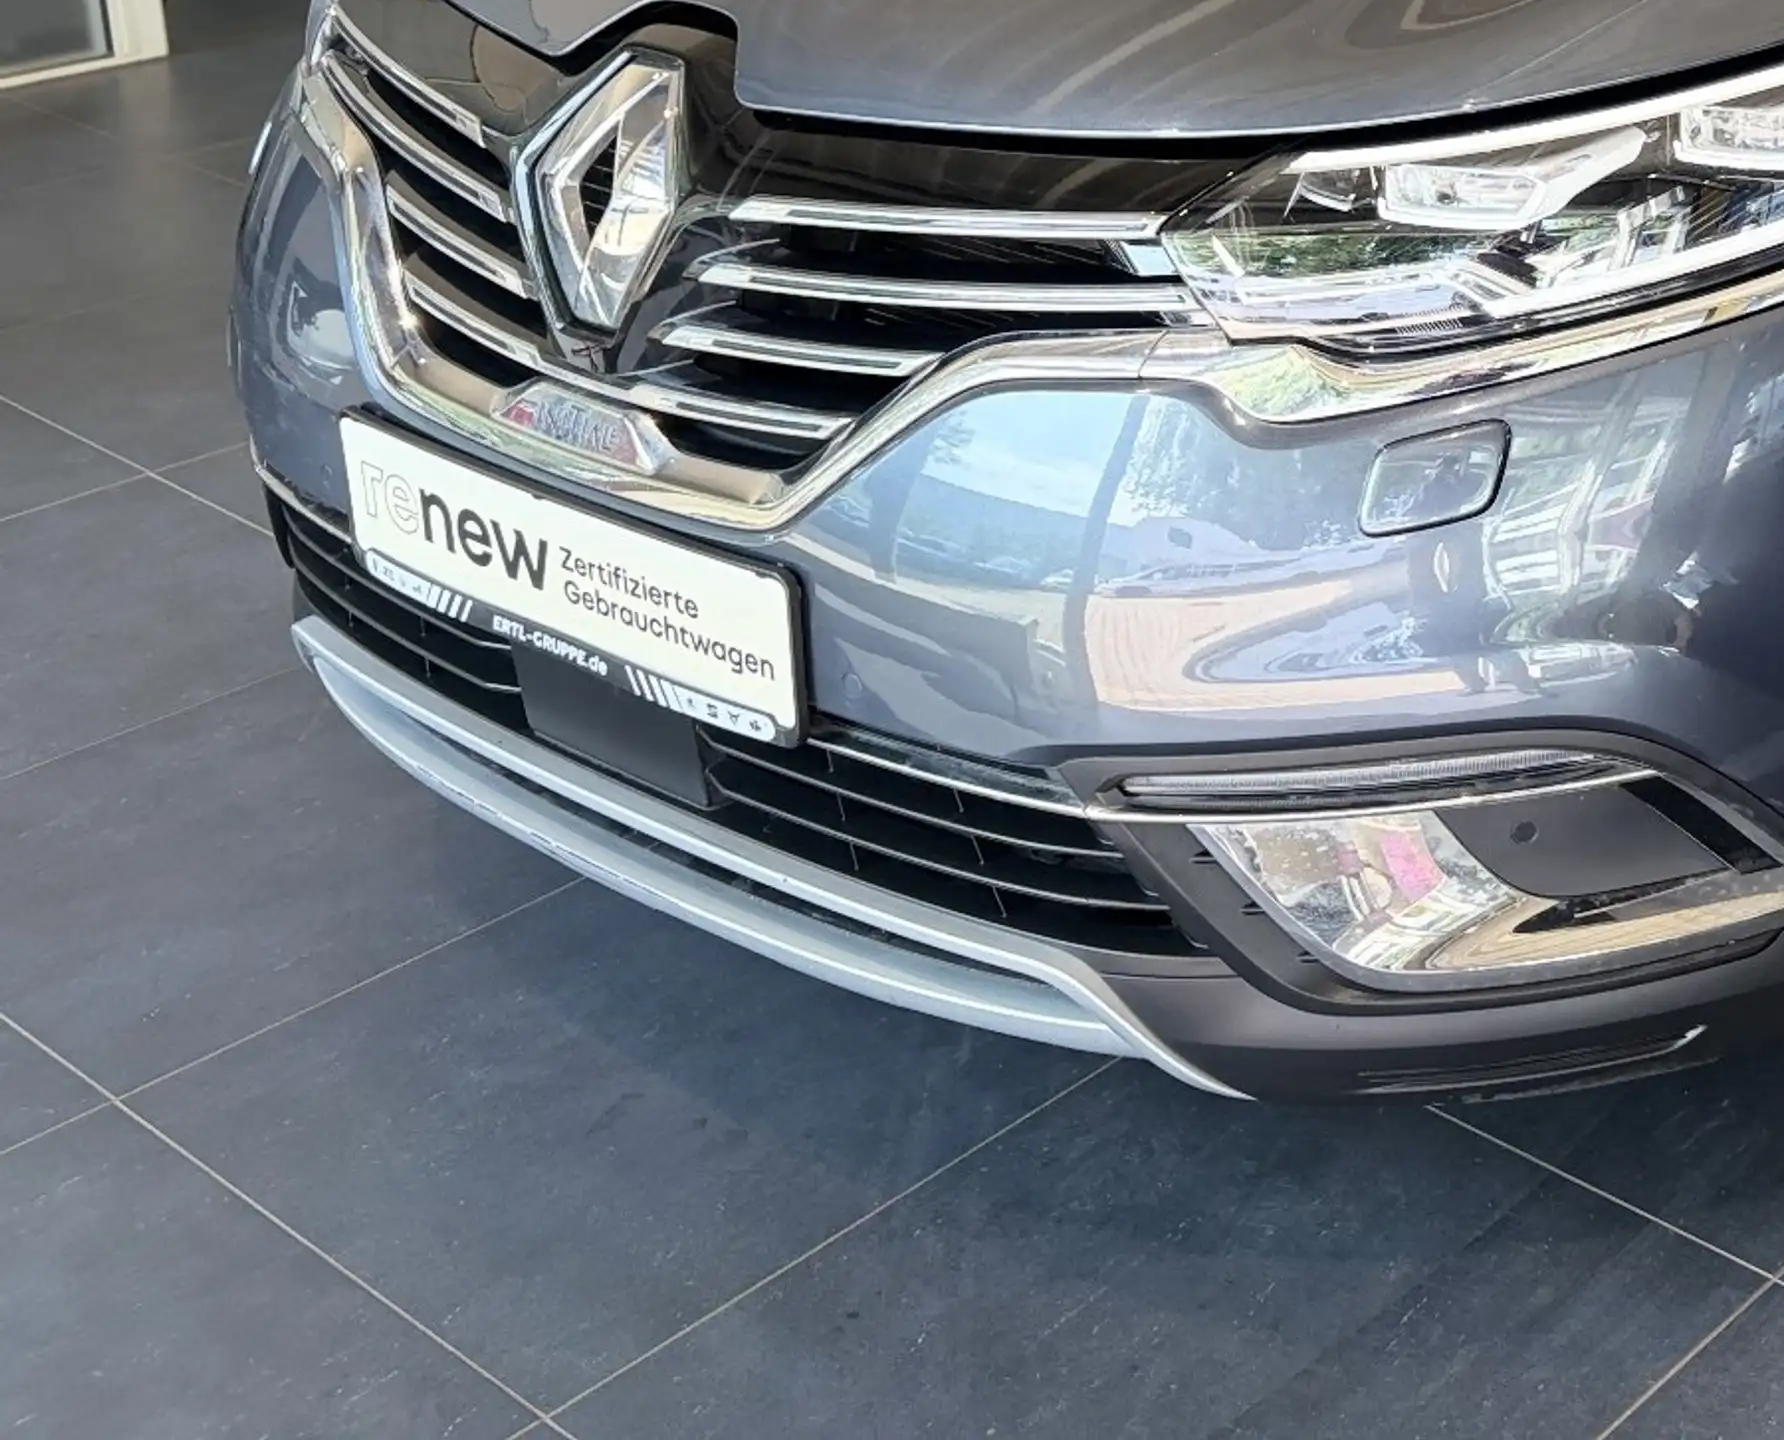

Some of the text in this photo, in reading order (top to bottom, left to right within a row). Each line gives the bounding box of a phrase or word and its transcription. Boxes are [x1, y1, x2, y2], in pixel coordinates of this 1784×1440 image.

[359, 459, 549, 591] renew
[558, 545, 700, 620] Zertifizierte
[492, 614, 609, 677] ERTL-GRUPPE.de
[563, 583, 777, 682] Gebrauchtwagen
